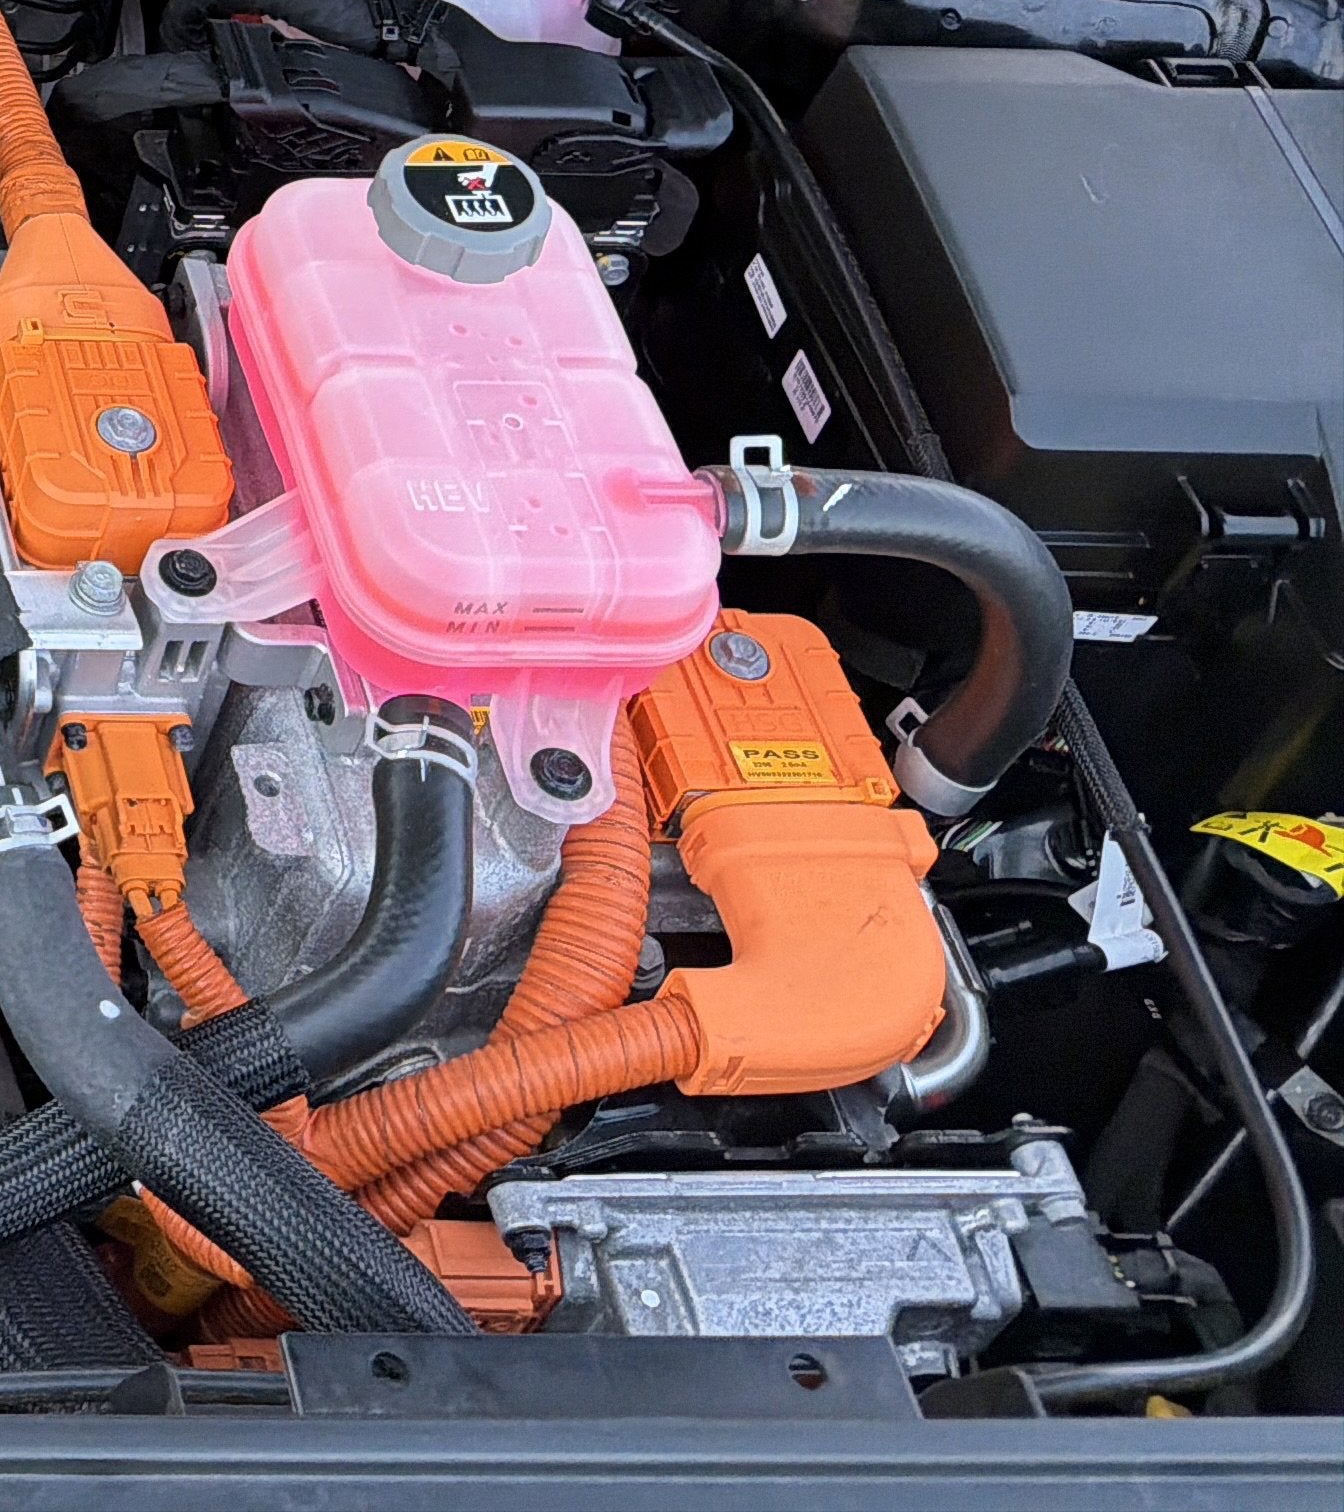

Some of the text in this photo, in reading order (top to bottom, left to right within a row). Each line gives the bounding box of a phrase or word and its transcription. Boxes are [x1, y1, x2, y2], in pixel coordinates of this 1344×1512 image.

[406, 479, 491, 513] HEV
[453, 601, 509, 616] MAX
[445, 620, 502, 635] MIN
[742, 749, 820, 760] PASS
